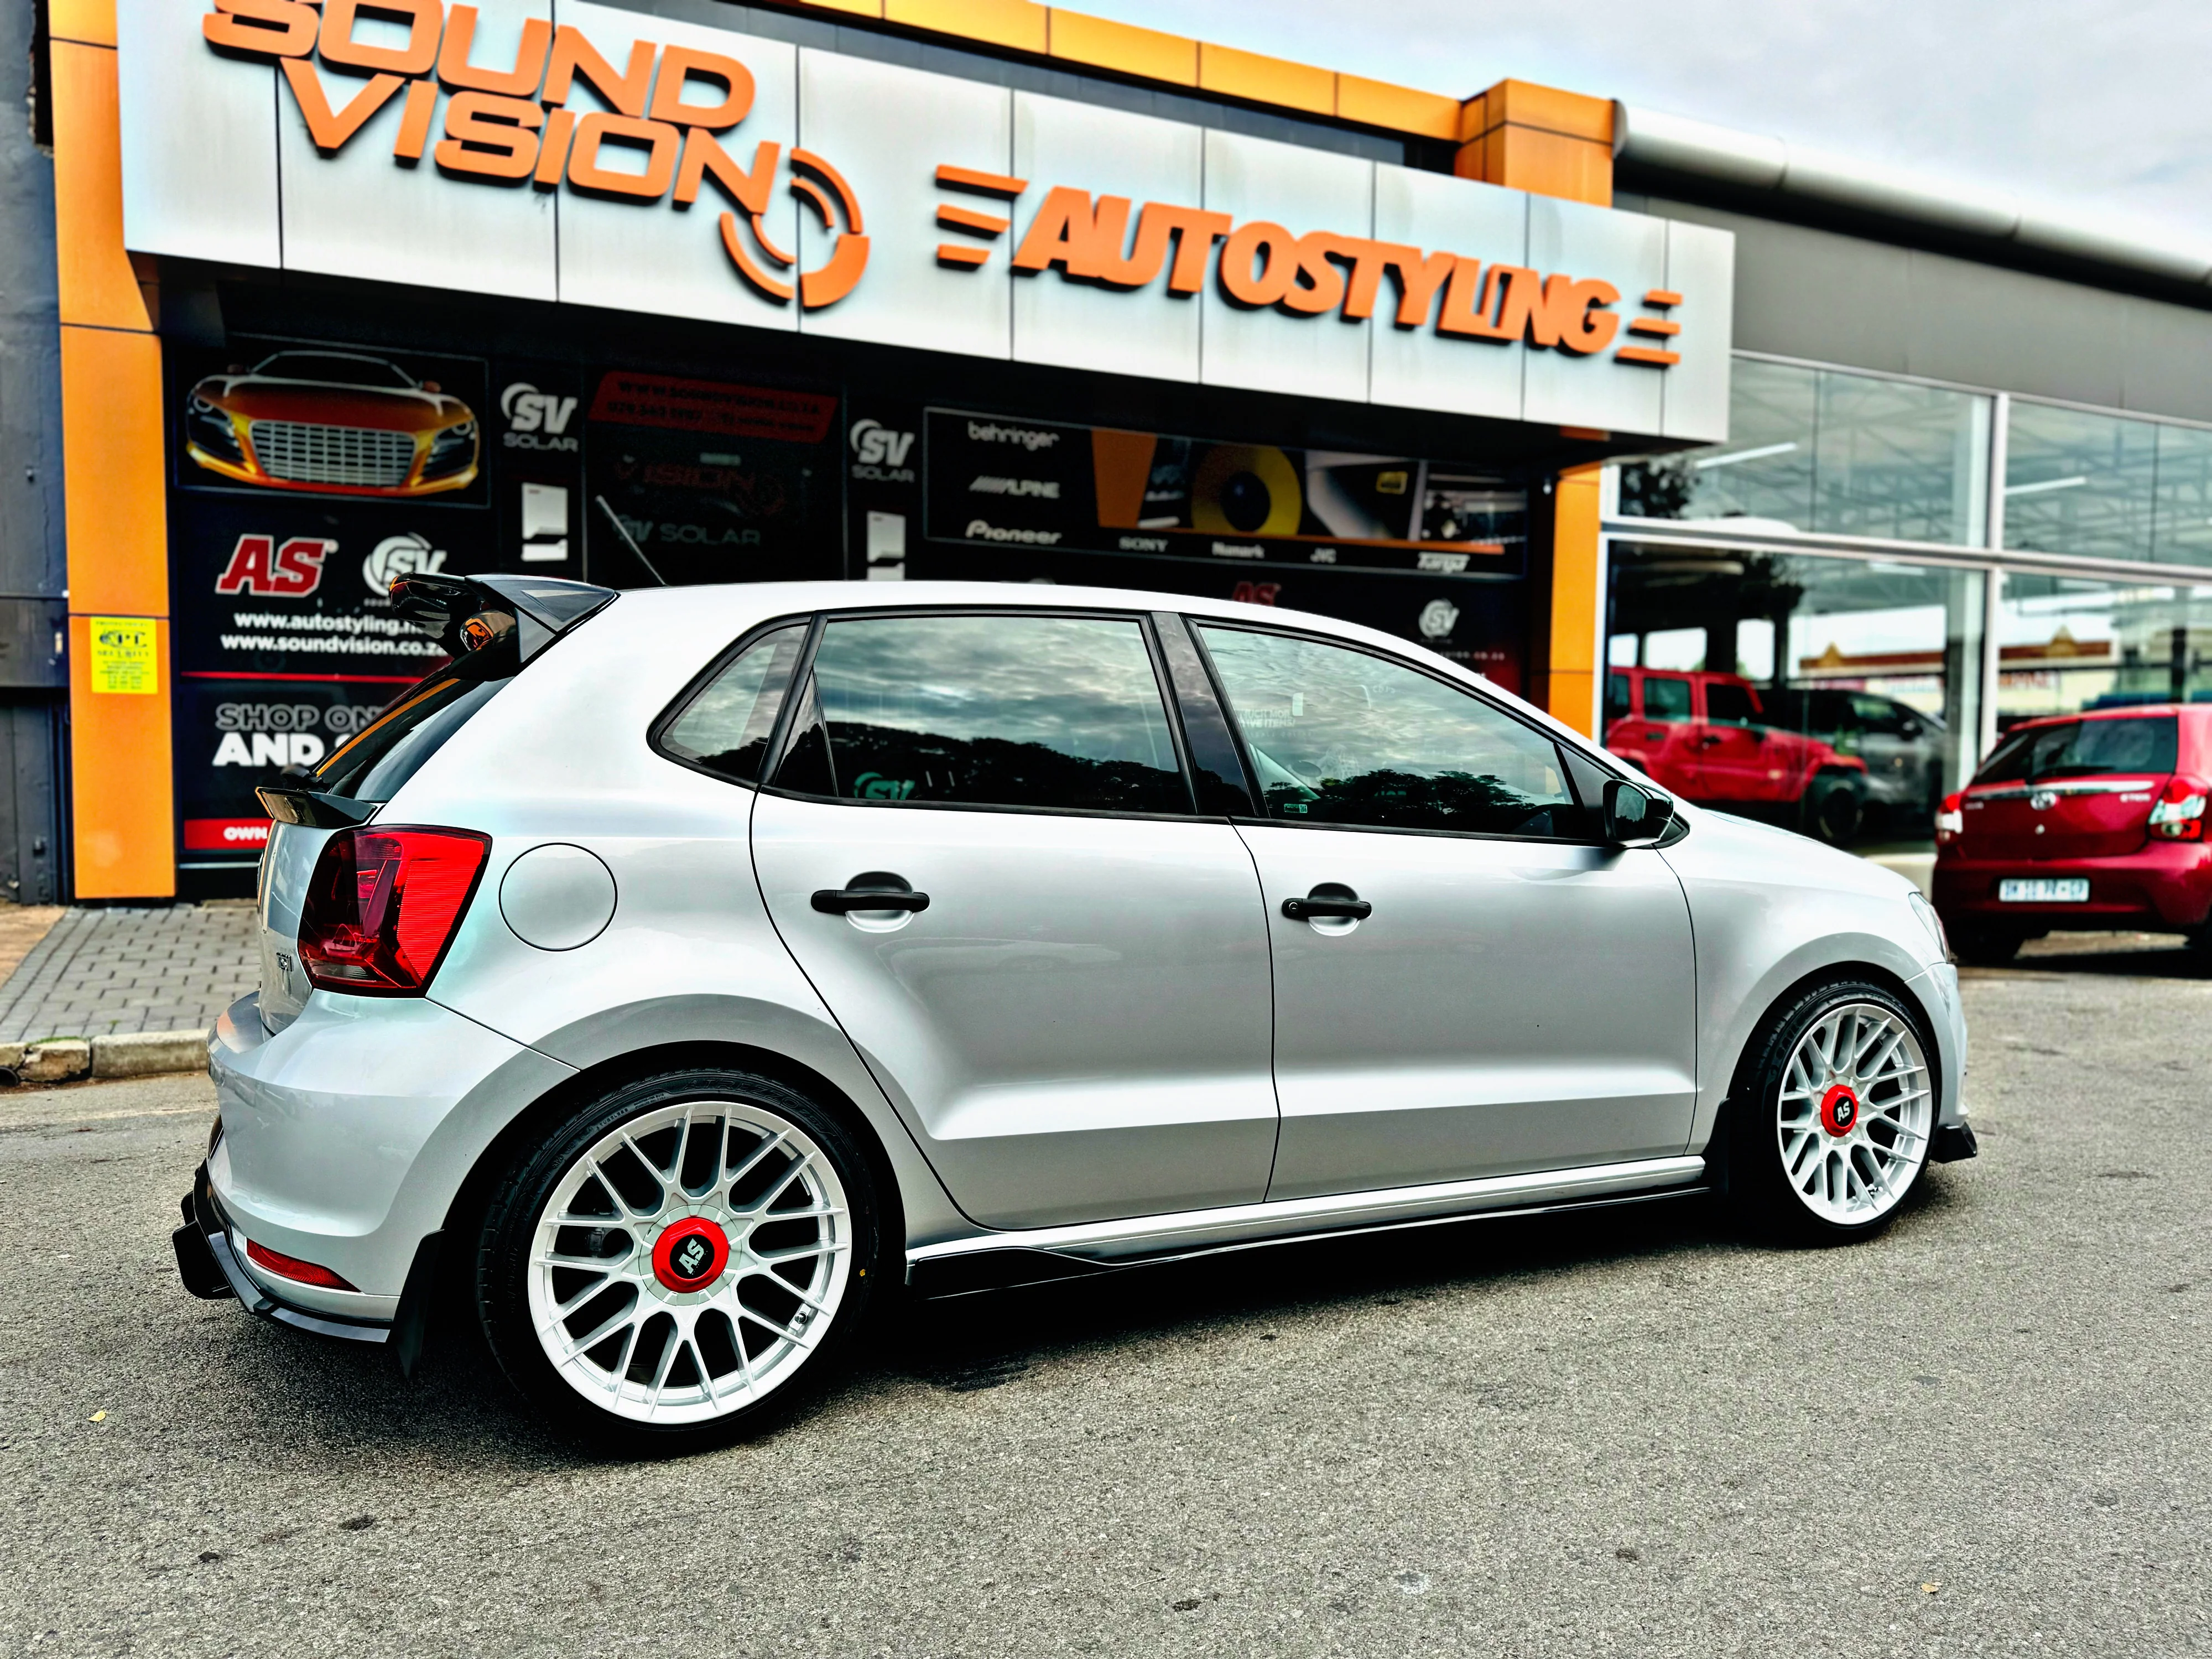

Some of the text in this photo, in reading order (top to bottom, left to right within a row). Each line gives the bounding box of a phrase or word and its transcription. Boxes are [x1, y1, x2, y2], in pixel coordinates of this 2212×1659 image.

[202, 0, 756, 129] SOUND
[279, 56, 781, 216] VISION
[1011, 185, 1621, 354] AUTOSTYLING
[510, 392, 579, 435] SV
[501, 431, 579, 453] SOLAR
[857, 428, 916, 467] SV
[967, 420, 1060, 451] behringer
[852, 464, 915, 483] SOLAR
[659, 522, 761, 547] SOLAR
[965, 519, 1063, 545] Pioneer
[1118, 535, 1168, 553] SONY
[215, 534, 333, 598] AS
[220, 633, 448, 657] www.soundvision.co.za
[215, 702, 320, 732] SHOP
[212, 732, 325, 767] AND
[683, 1078, 800, 1109] ATREZZO
[1837, 1100, 1850, 1122] AS
[678, 1237, 705, 1274] AS
